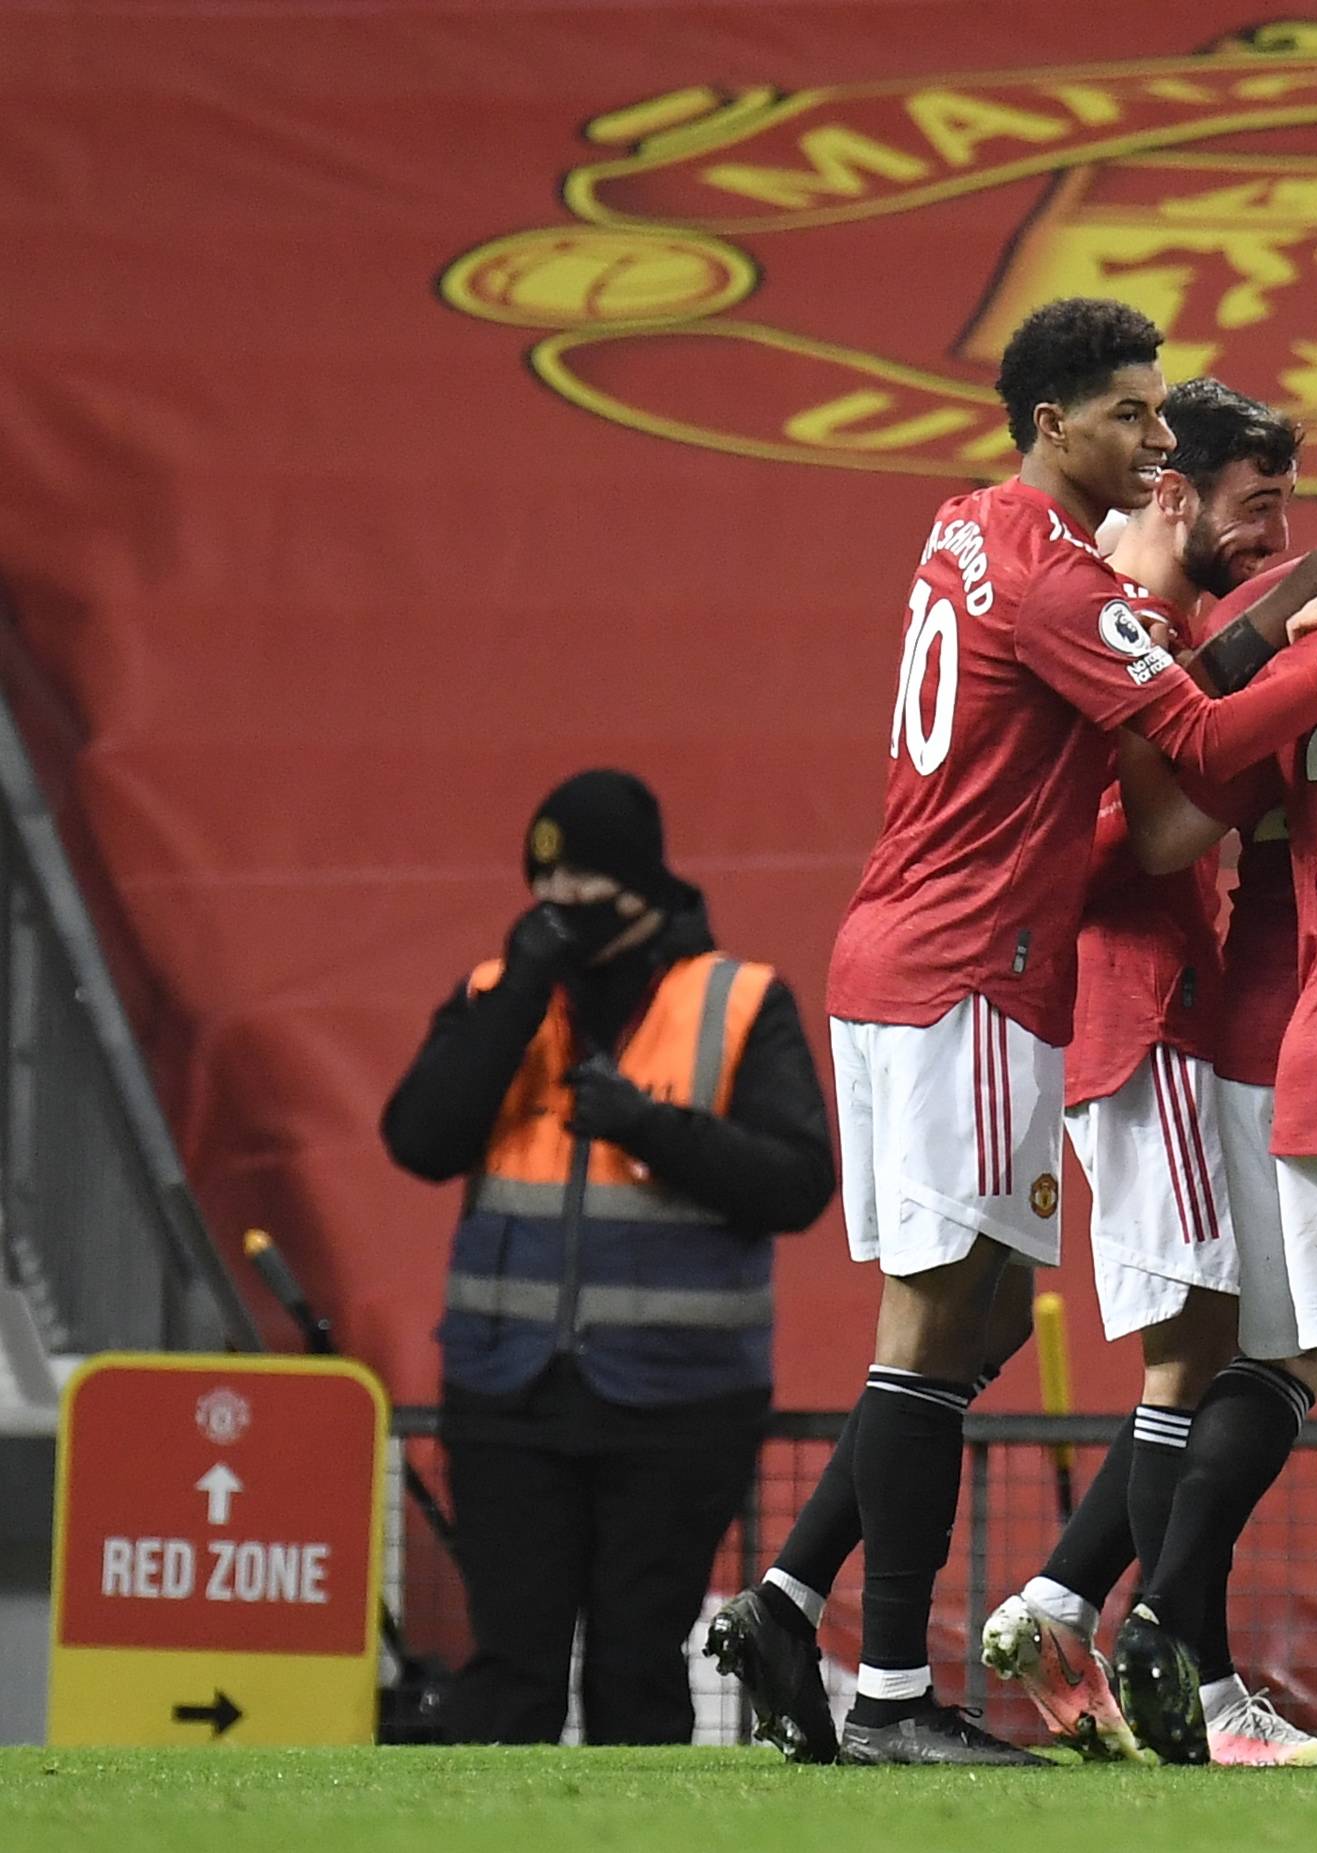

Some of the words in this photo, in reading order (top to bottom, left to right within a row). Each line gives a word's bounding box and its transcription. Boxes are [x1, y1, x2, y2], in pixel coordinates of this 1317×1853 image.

[920, 519, 994, 616] ASHFORD
[890, 578, 958, 776] 10
[101, 1536, 195, 1599] RED
[206, 1540, 330, 1604] ZONE
